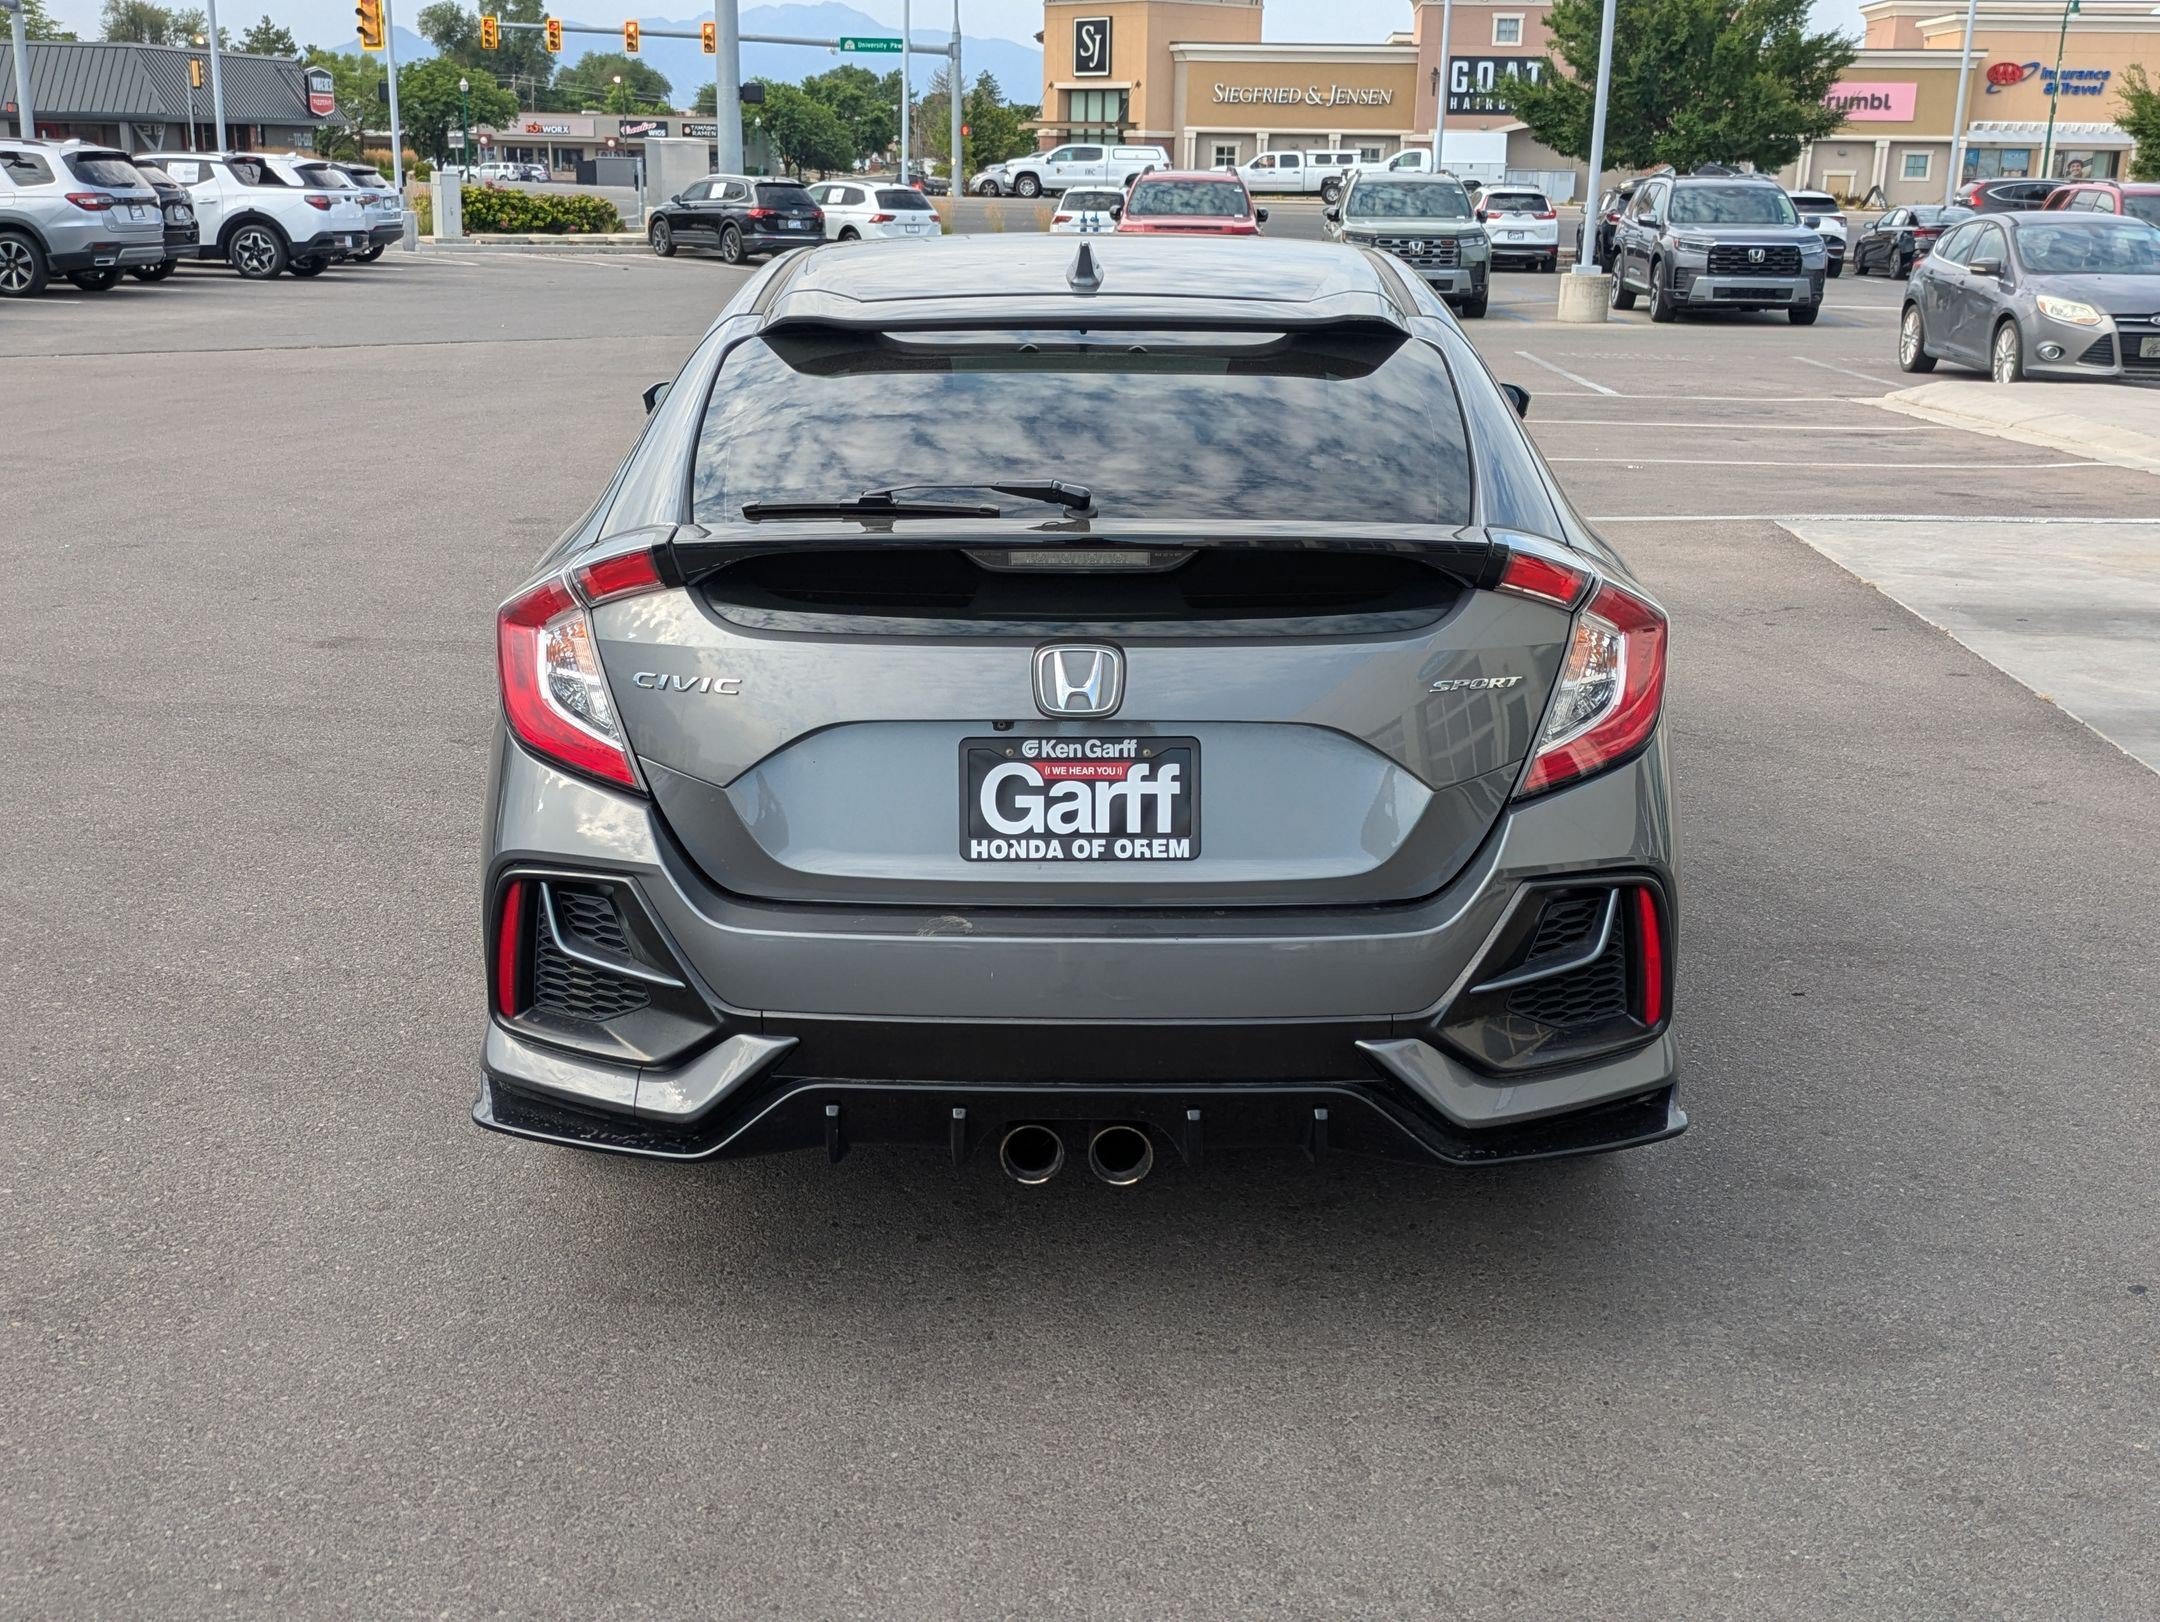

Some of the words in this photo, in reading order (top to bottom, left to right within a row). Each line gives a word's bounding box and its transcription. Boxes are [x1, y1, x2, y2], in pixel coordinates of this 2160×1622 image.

[857, 41, 888, 51] University
[890, 42, 903, 50] Pkw
[1080, 25, 1102, 68] SJ
[2041, 67, 2112, 81] Inurance
[1212, 83, 1302, 104] SIEGFRIED
[1305, 85, 1323, 105] &
[1326, 84, 1393, 107] JENSEN
[2060, 81, 2105, 96] Travel
[1824, 93, 1892, 111] rumbl
[648, 129, 666, 137] WIGS
[632, 671, 742, 695] CIVIC
[1428, 676, 1523, 694] SPORT
[1041, 739, 1082, 758] Ken
[1084, 739, 1137, 758] Garff
[1050, 766, 1067, 776] WE
[1069, 766, 1095, 776] HEAR
[1096, 766, 1117, 776] YOU
[980, 762, 1181, 835] Garff
[970, 839, 1064, 859] HONDA
[1071, 839, 1106, 859] OF
[1113, 839, 1190, 859] OREM
